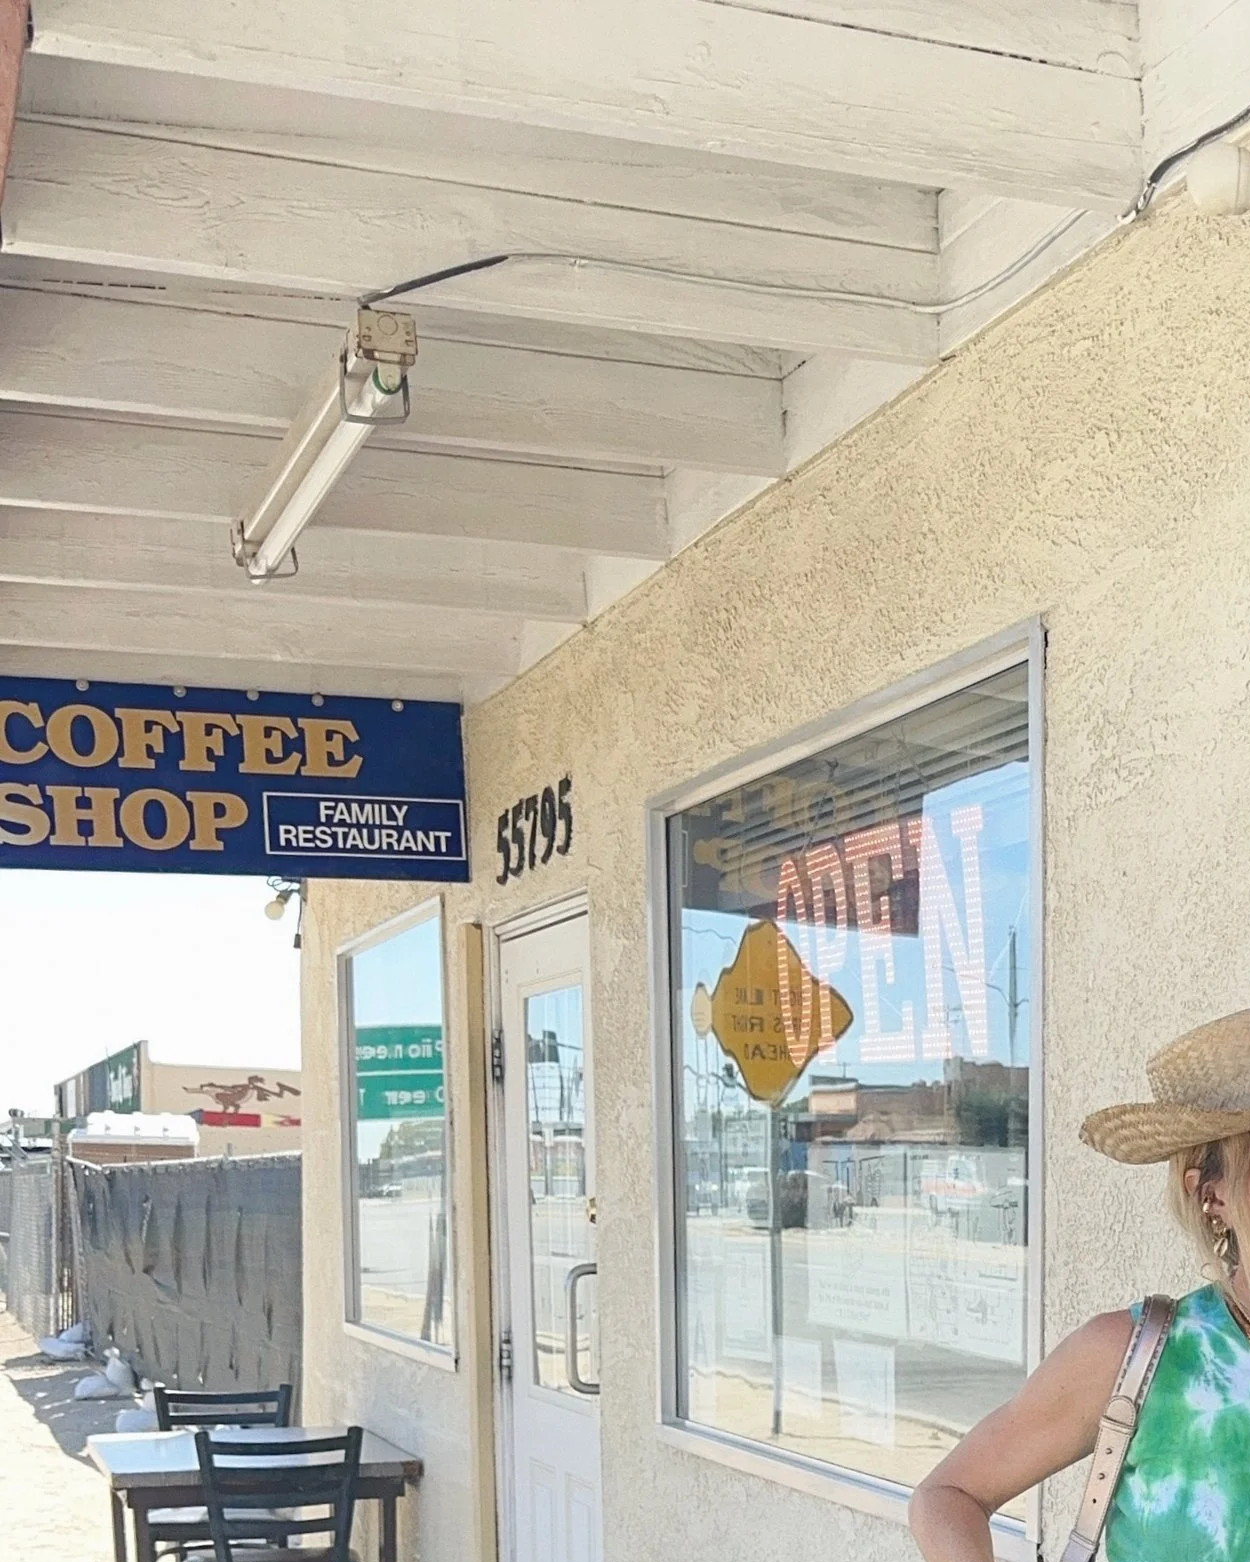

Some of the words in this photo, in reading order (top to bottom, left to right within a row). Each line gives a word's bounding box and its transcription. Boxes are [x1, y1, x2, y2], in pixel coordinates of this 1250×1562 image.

[0, 700, 363, 779] COFFEE
[0, 781, 249, 852] SHOP
[278, 825, 453, 854] RESTAURANT
[319, 800, 409, 826] FAMILY
[496, 772, 573, 886] 55795
[776, 805, 989, 1067] OPEN
